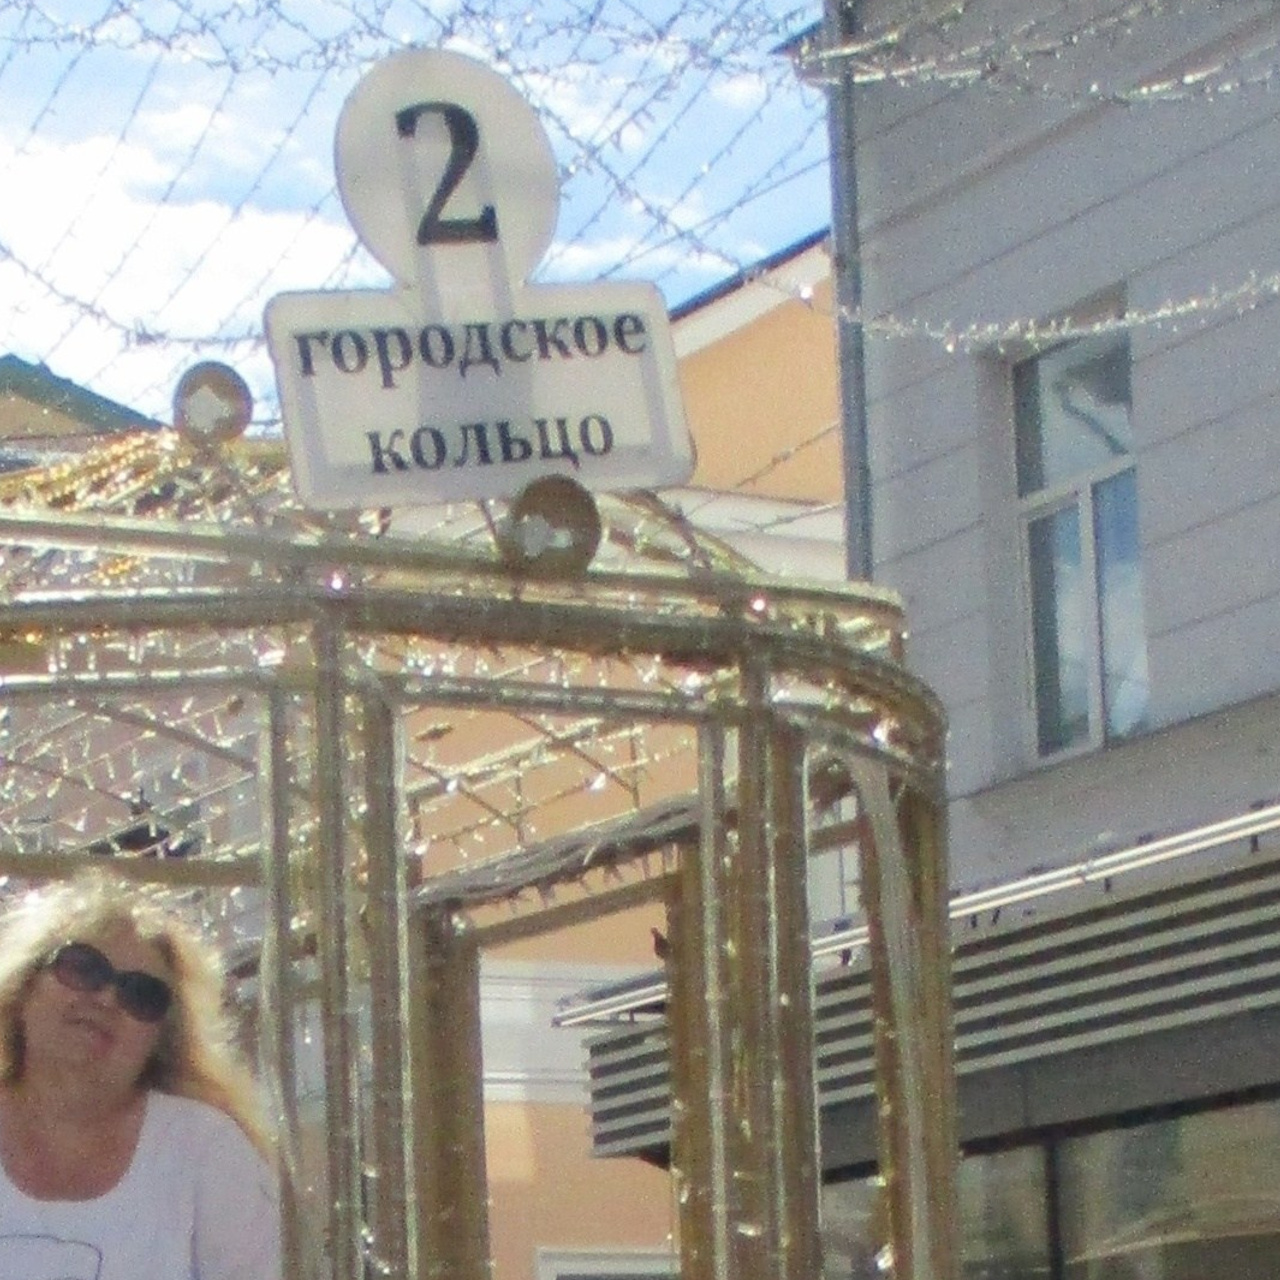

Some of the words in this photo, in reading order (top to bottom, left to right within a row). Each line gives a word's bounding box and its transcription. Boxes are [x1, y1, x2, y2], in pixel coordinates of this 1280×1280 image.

[395, 101, 498, 246] 2
[294, 312, 647, 390] городское
[366, 414, 614, 475] кольцо
